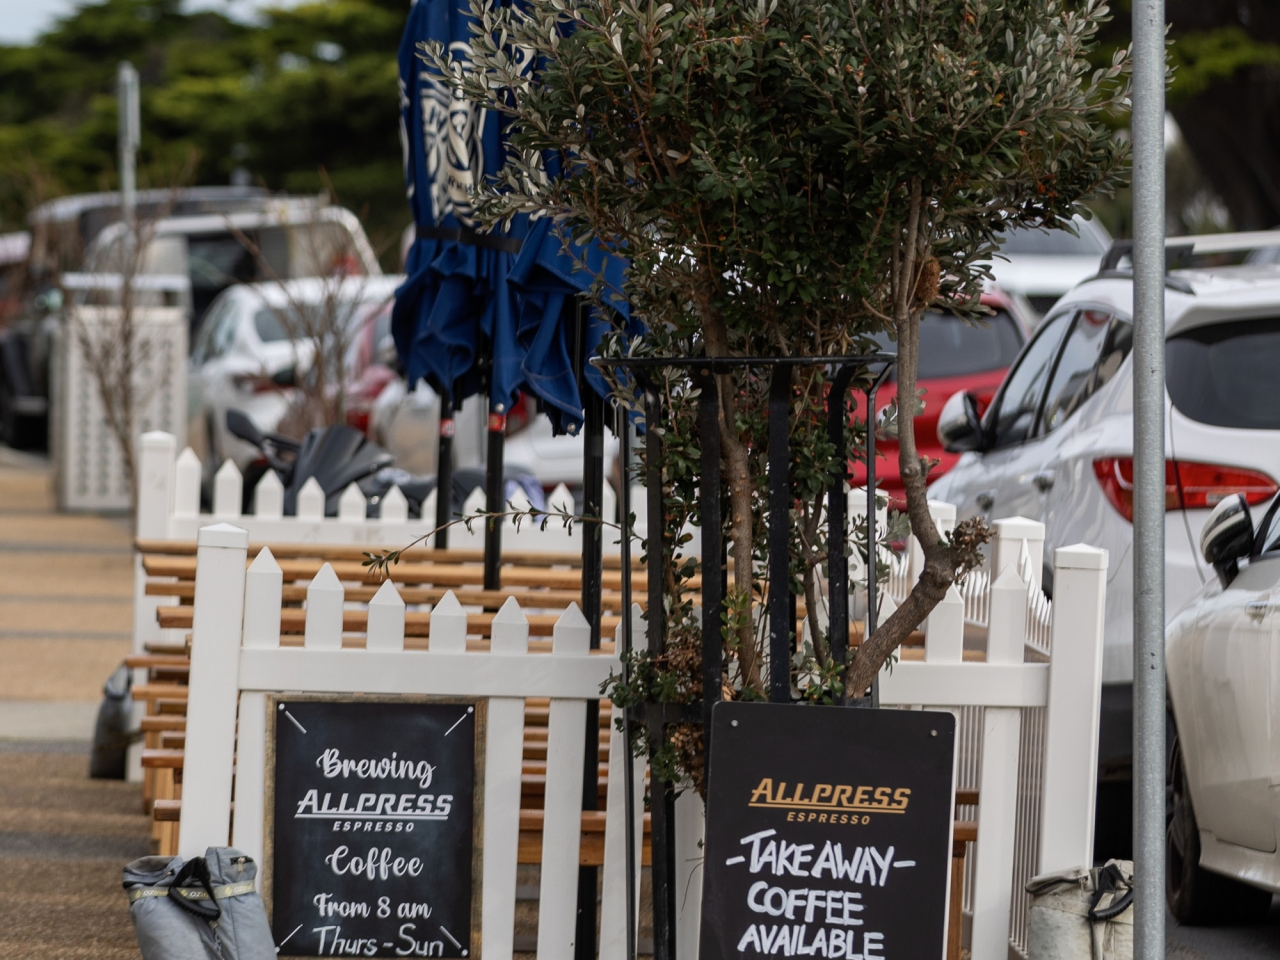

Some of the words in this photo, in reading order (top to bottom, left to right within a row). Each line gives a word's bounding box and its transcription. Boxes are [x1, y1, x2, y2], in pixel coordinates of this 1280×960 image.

[316, 748, 436, 789] Brewing
[297, 789, 453, 816] ALLPRESS
[750, 778, 912, 809] ALLPRESS
[332, 821, 415, 832] ESPRESSO
[786, 811, 870, 825] ESPRESSO
[325, 845, 424, 881] Coffee
[313, 893, 371, 918] From
[376, 896, 391, 918] 8
[397, 901, 432, 919] am
[747, 880, 864, 925] COFFEE
[737, 924, 885, 960] AVAILABLE
